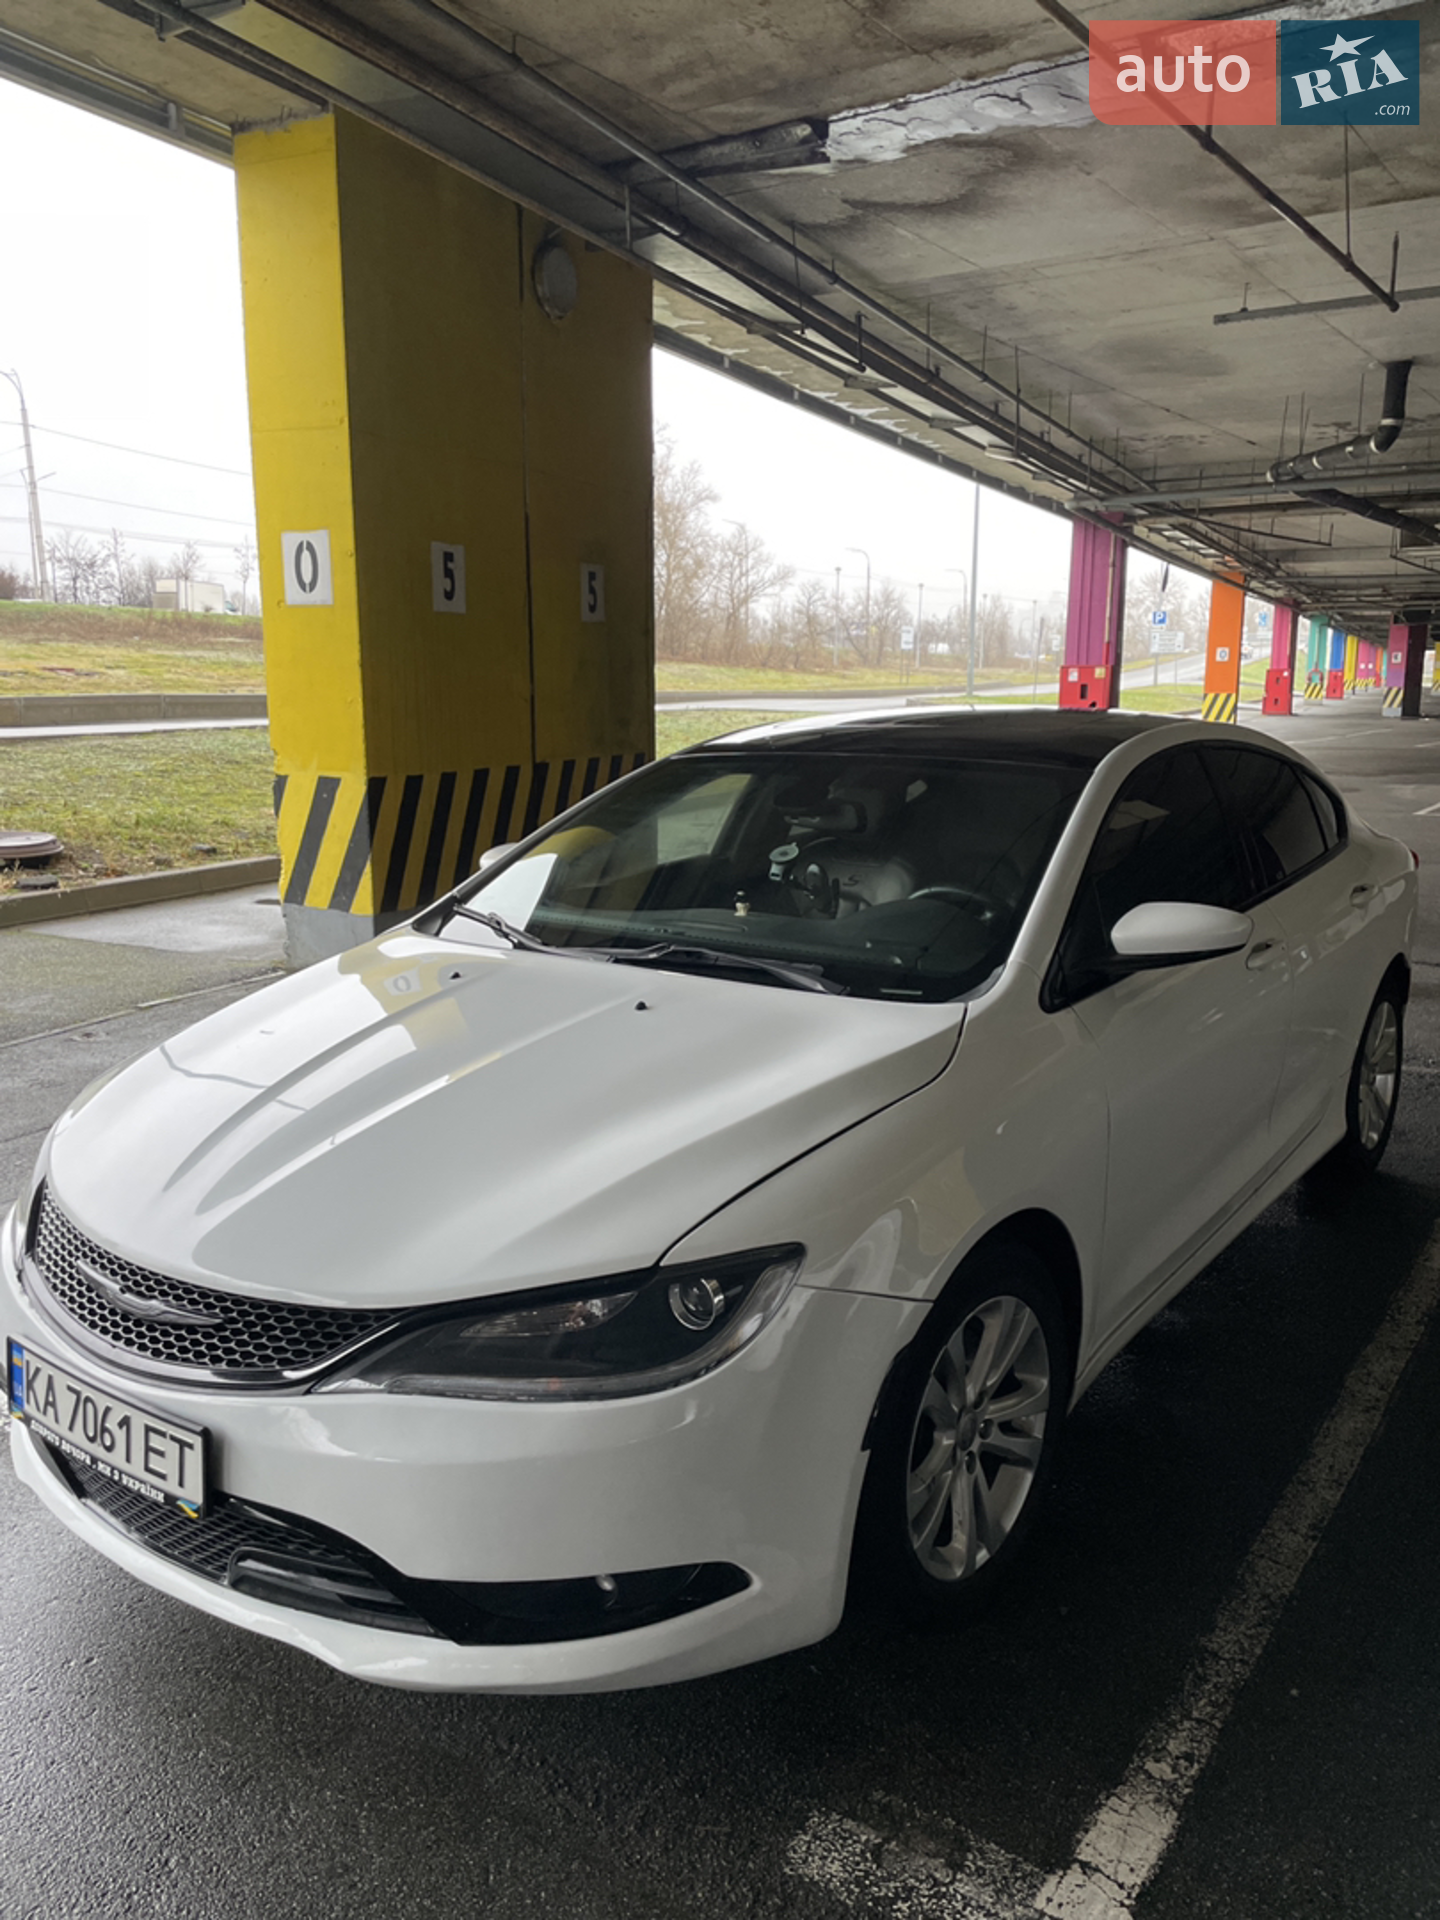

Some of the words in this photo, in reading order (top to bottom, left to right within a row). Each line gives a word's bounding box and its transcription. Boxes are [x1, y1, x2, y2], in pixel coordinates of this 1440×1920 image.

[294, 539, 319, 594] 0
[443, 551, 456, 601] 5
[588, 571, 598, 613] 5
[26, 1359, 59, 1424] KA
[66, 1384, 131, 1464] 7061
[144, 1422, 194, 1489] ET
